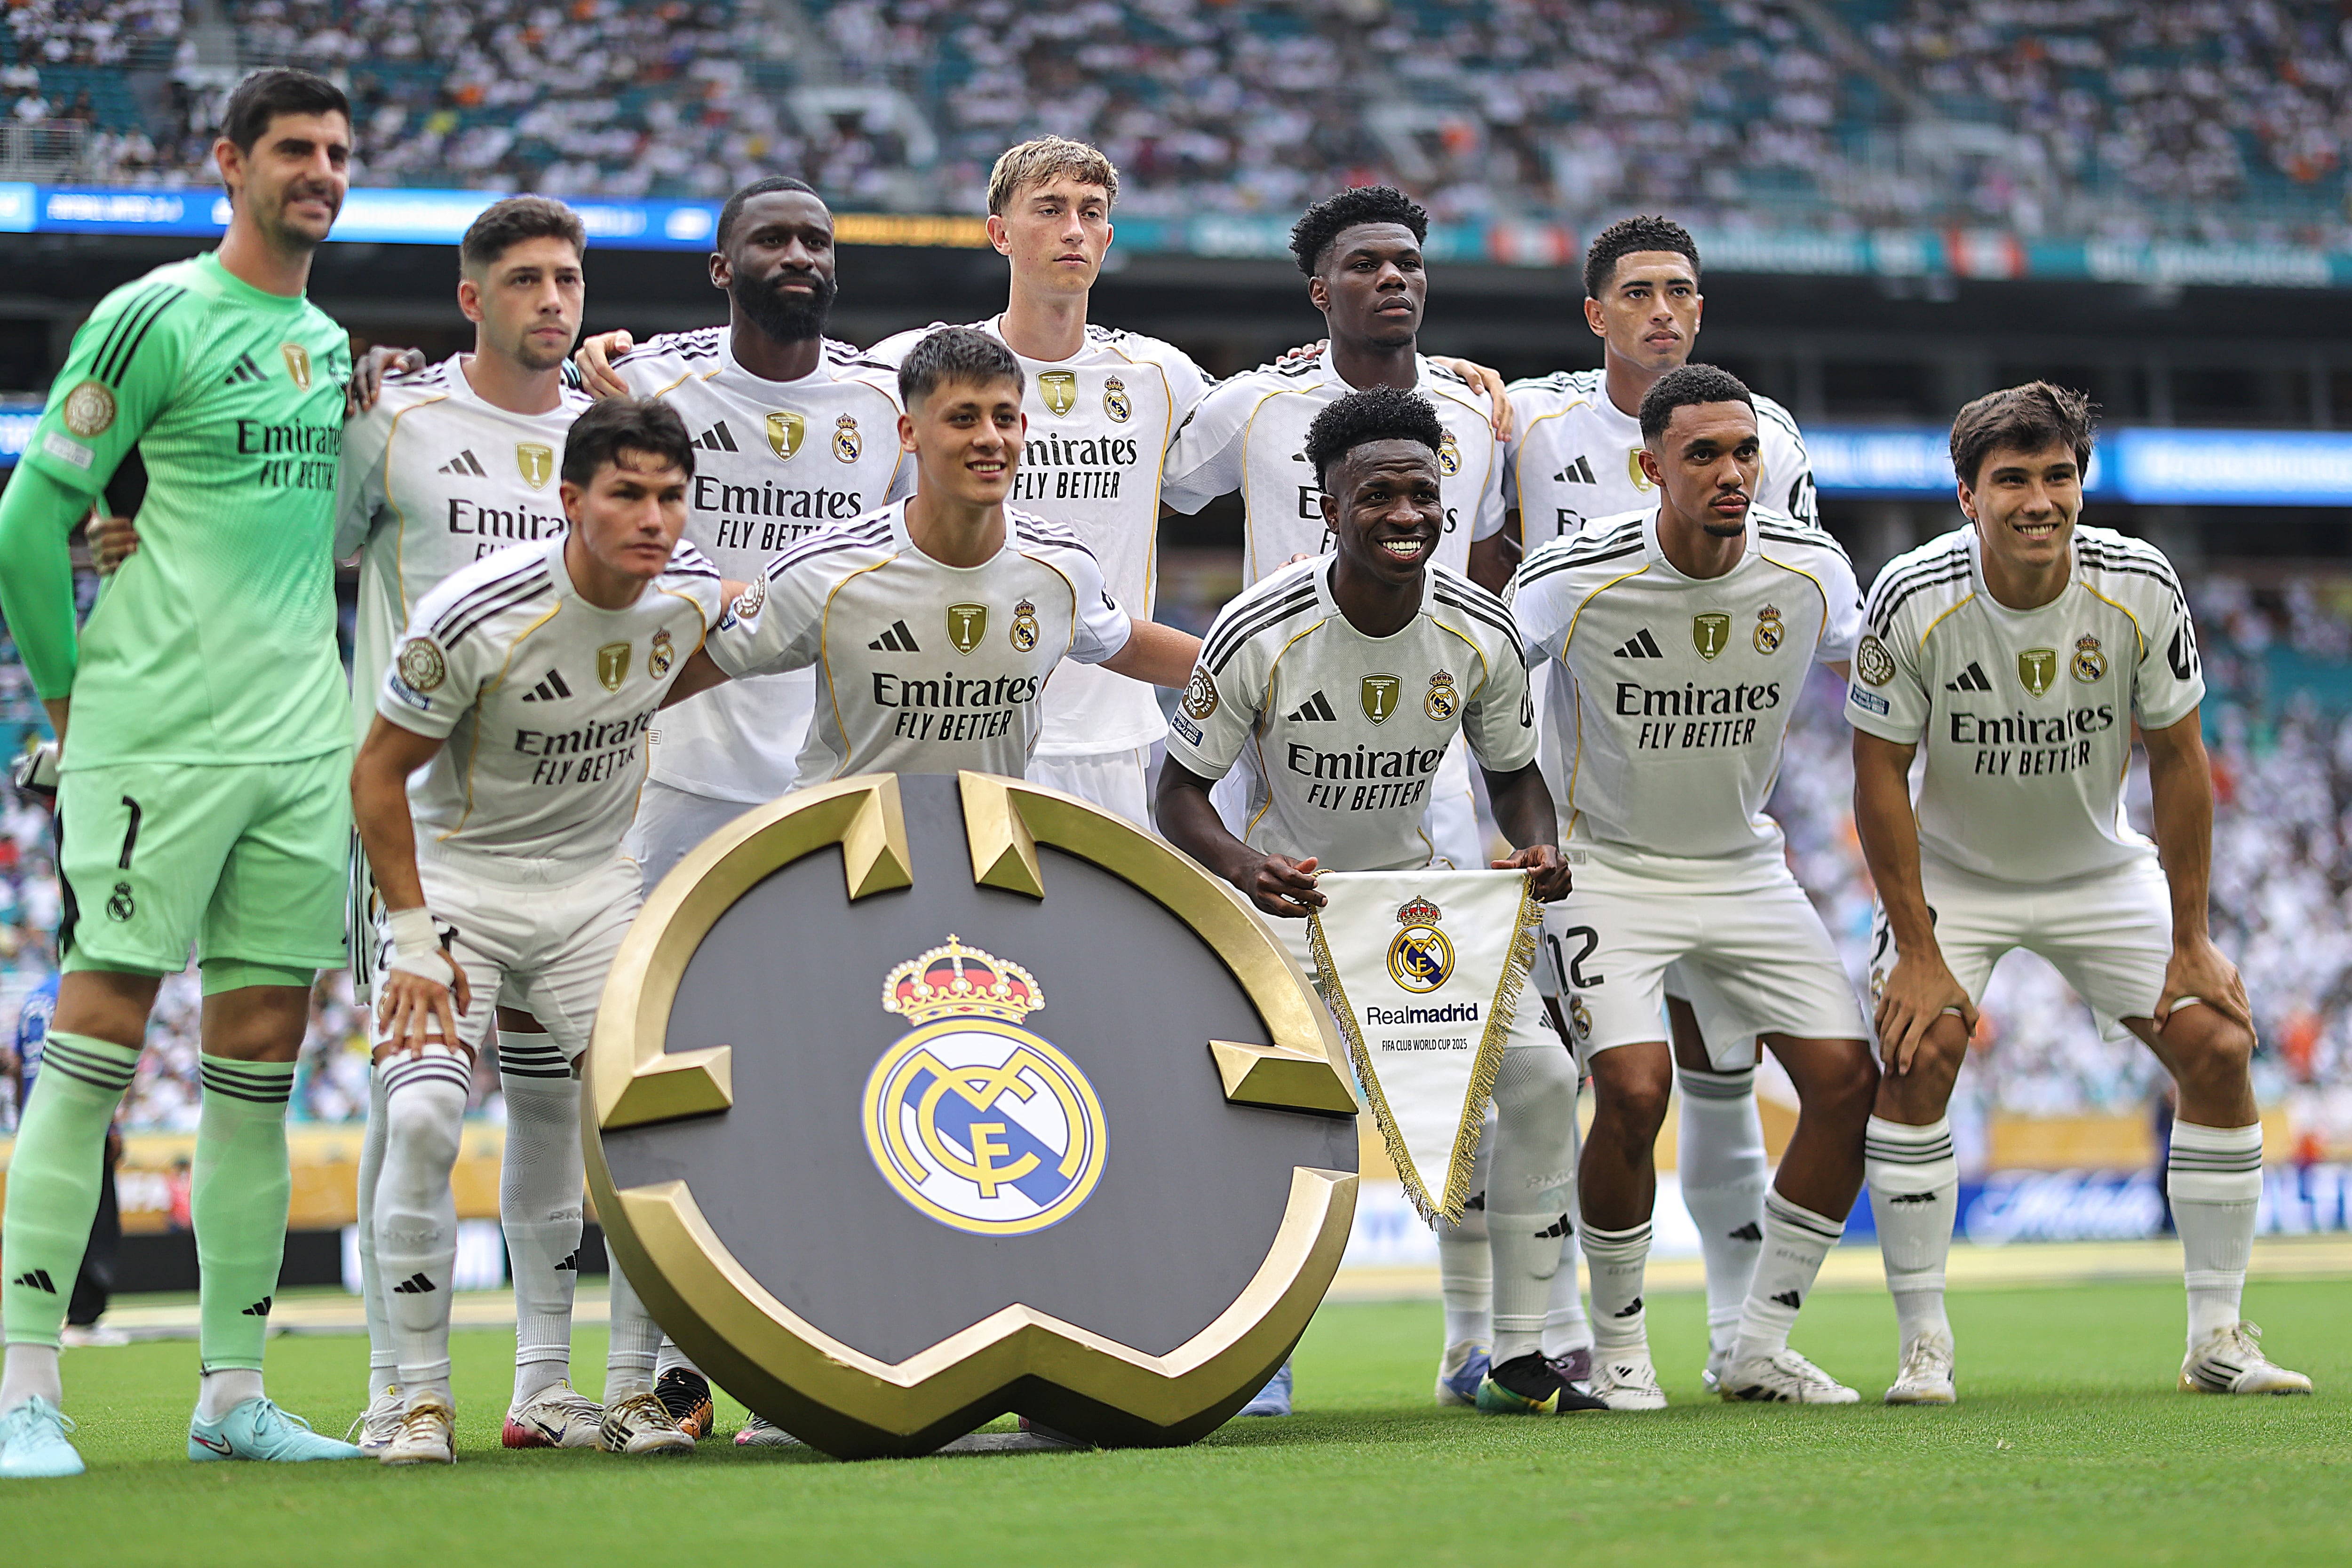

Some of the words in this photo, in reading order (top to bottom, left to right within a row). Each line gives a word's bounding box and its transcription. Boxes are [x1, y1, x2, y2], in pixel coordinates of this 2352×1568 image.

[237, 418, 342, 457] Emirate
[1019, 433, 1137, 466] mirates
[695, 475, 862, 519] Emirates
[1013, 473, 1048, 500] FLY
[1057, 471, 1120, 499] BETTER
[448, 499, 565, 540] Emira
[716, 520, 755, 550] FLY
[872, 672, 1039, 708] Emirates
[1203, 678, 1212, 691] CUP
[1208, 694, 1214, 703] 25
[1616, 682, 1780, 716] Emirates
[1185, 699, 1198, 716] FIFA
[1200, 703, 1211, 713] USA
[515, 707, 658, 756] Emirate
[895, 712, 934, 740] FLY
[938, 709, 1013, 741] BETTER
[1638, 723, 1676, 749] FLY
[1682, 718, 1756, 748] BETTER
[1950, 704, 2114, 745] Emirates
[532, 759, 574, 785] FLY
[1975, 749, 2011, 776] FLY
[1307, 783, 1347, 810] FLY
[1351, 779, 1426, 811] BETTER
[1547, 925, 1604, 996] 12
[1367, 1003, 1478, 1025] Realmadrid
[1382, 1040, 1395, 1051] FIFA
[1396, 1040, 1412, 1051] CLUB
[1413, 1039, 1437, 1050] WORLD
[1438, 1039, 1451, 1050] CUP
[1452, 1038, 1467, 1049] 2025
